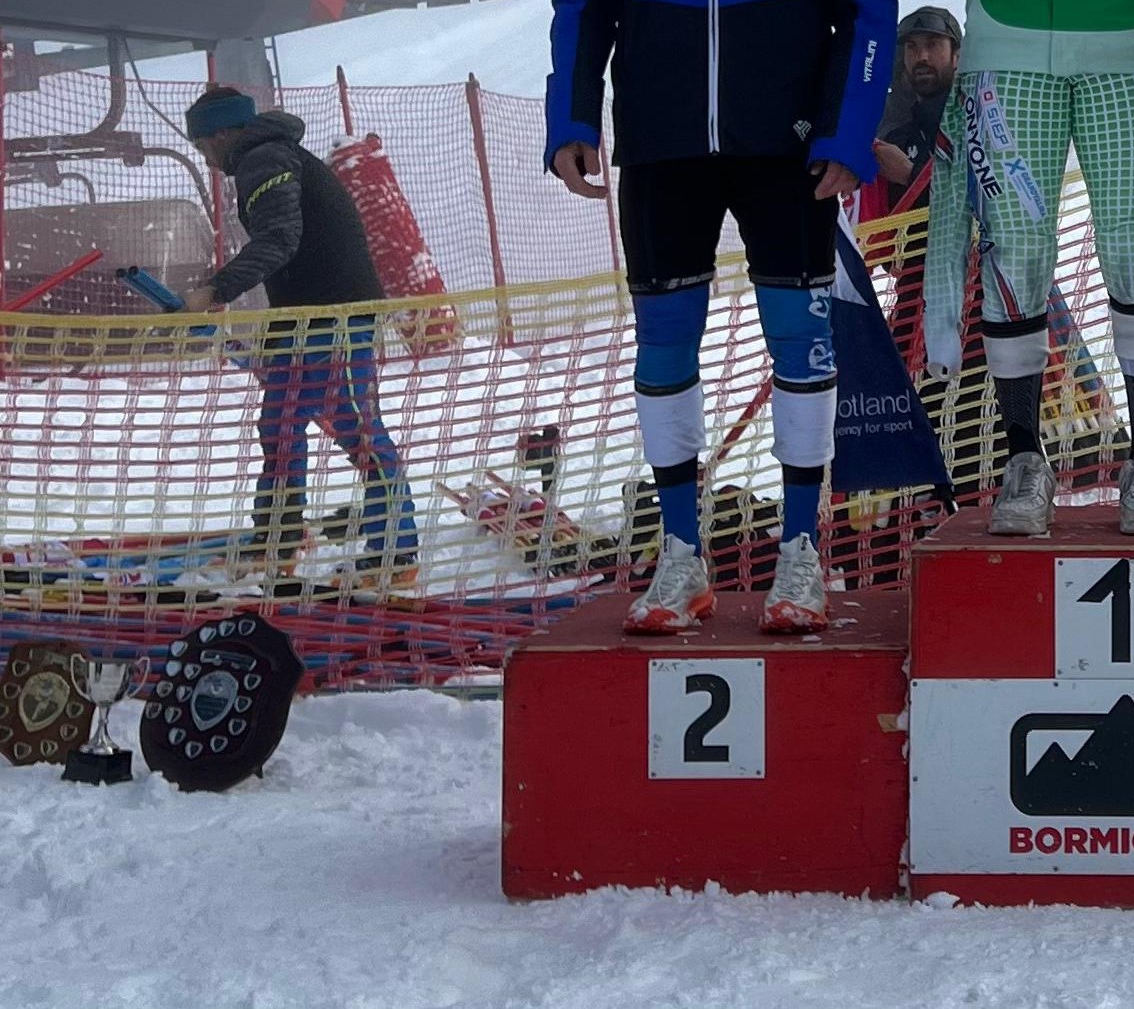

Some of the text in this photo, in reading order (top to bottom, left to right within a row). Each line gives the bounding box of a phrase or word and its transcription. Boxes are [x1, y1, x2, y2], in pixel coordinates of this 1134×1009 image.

[963, 96, 1003, 200] ONYONE
[837, 388, 912, 418] otland
[865, 423, 882, 435] for
[883, 419, 914, 435] sport
[1076, 557, 1131, 663] 1
[683, 673, 731, 763] 2
